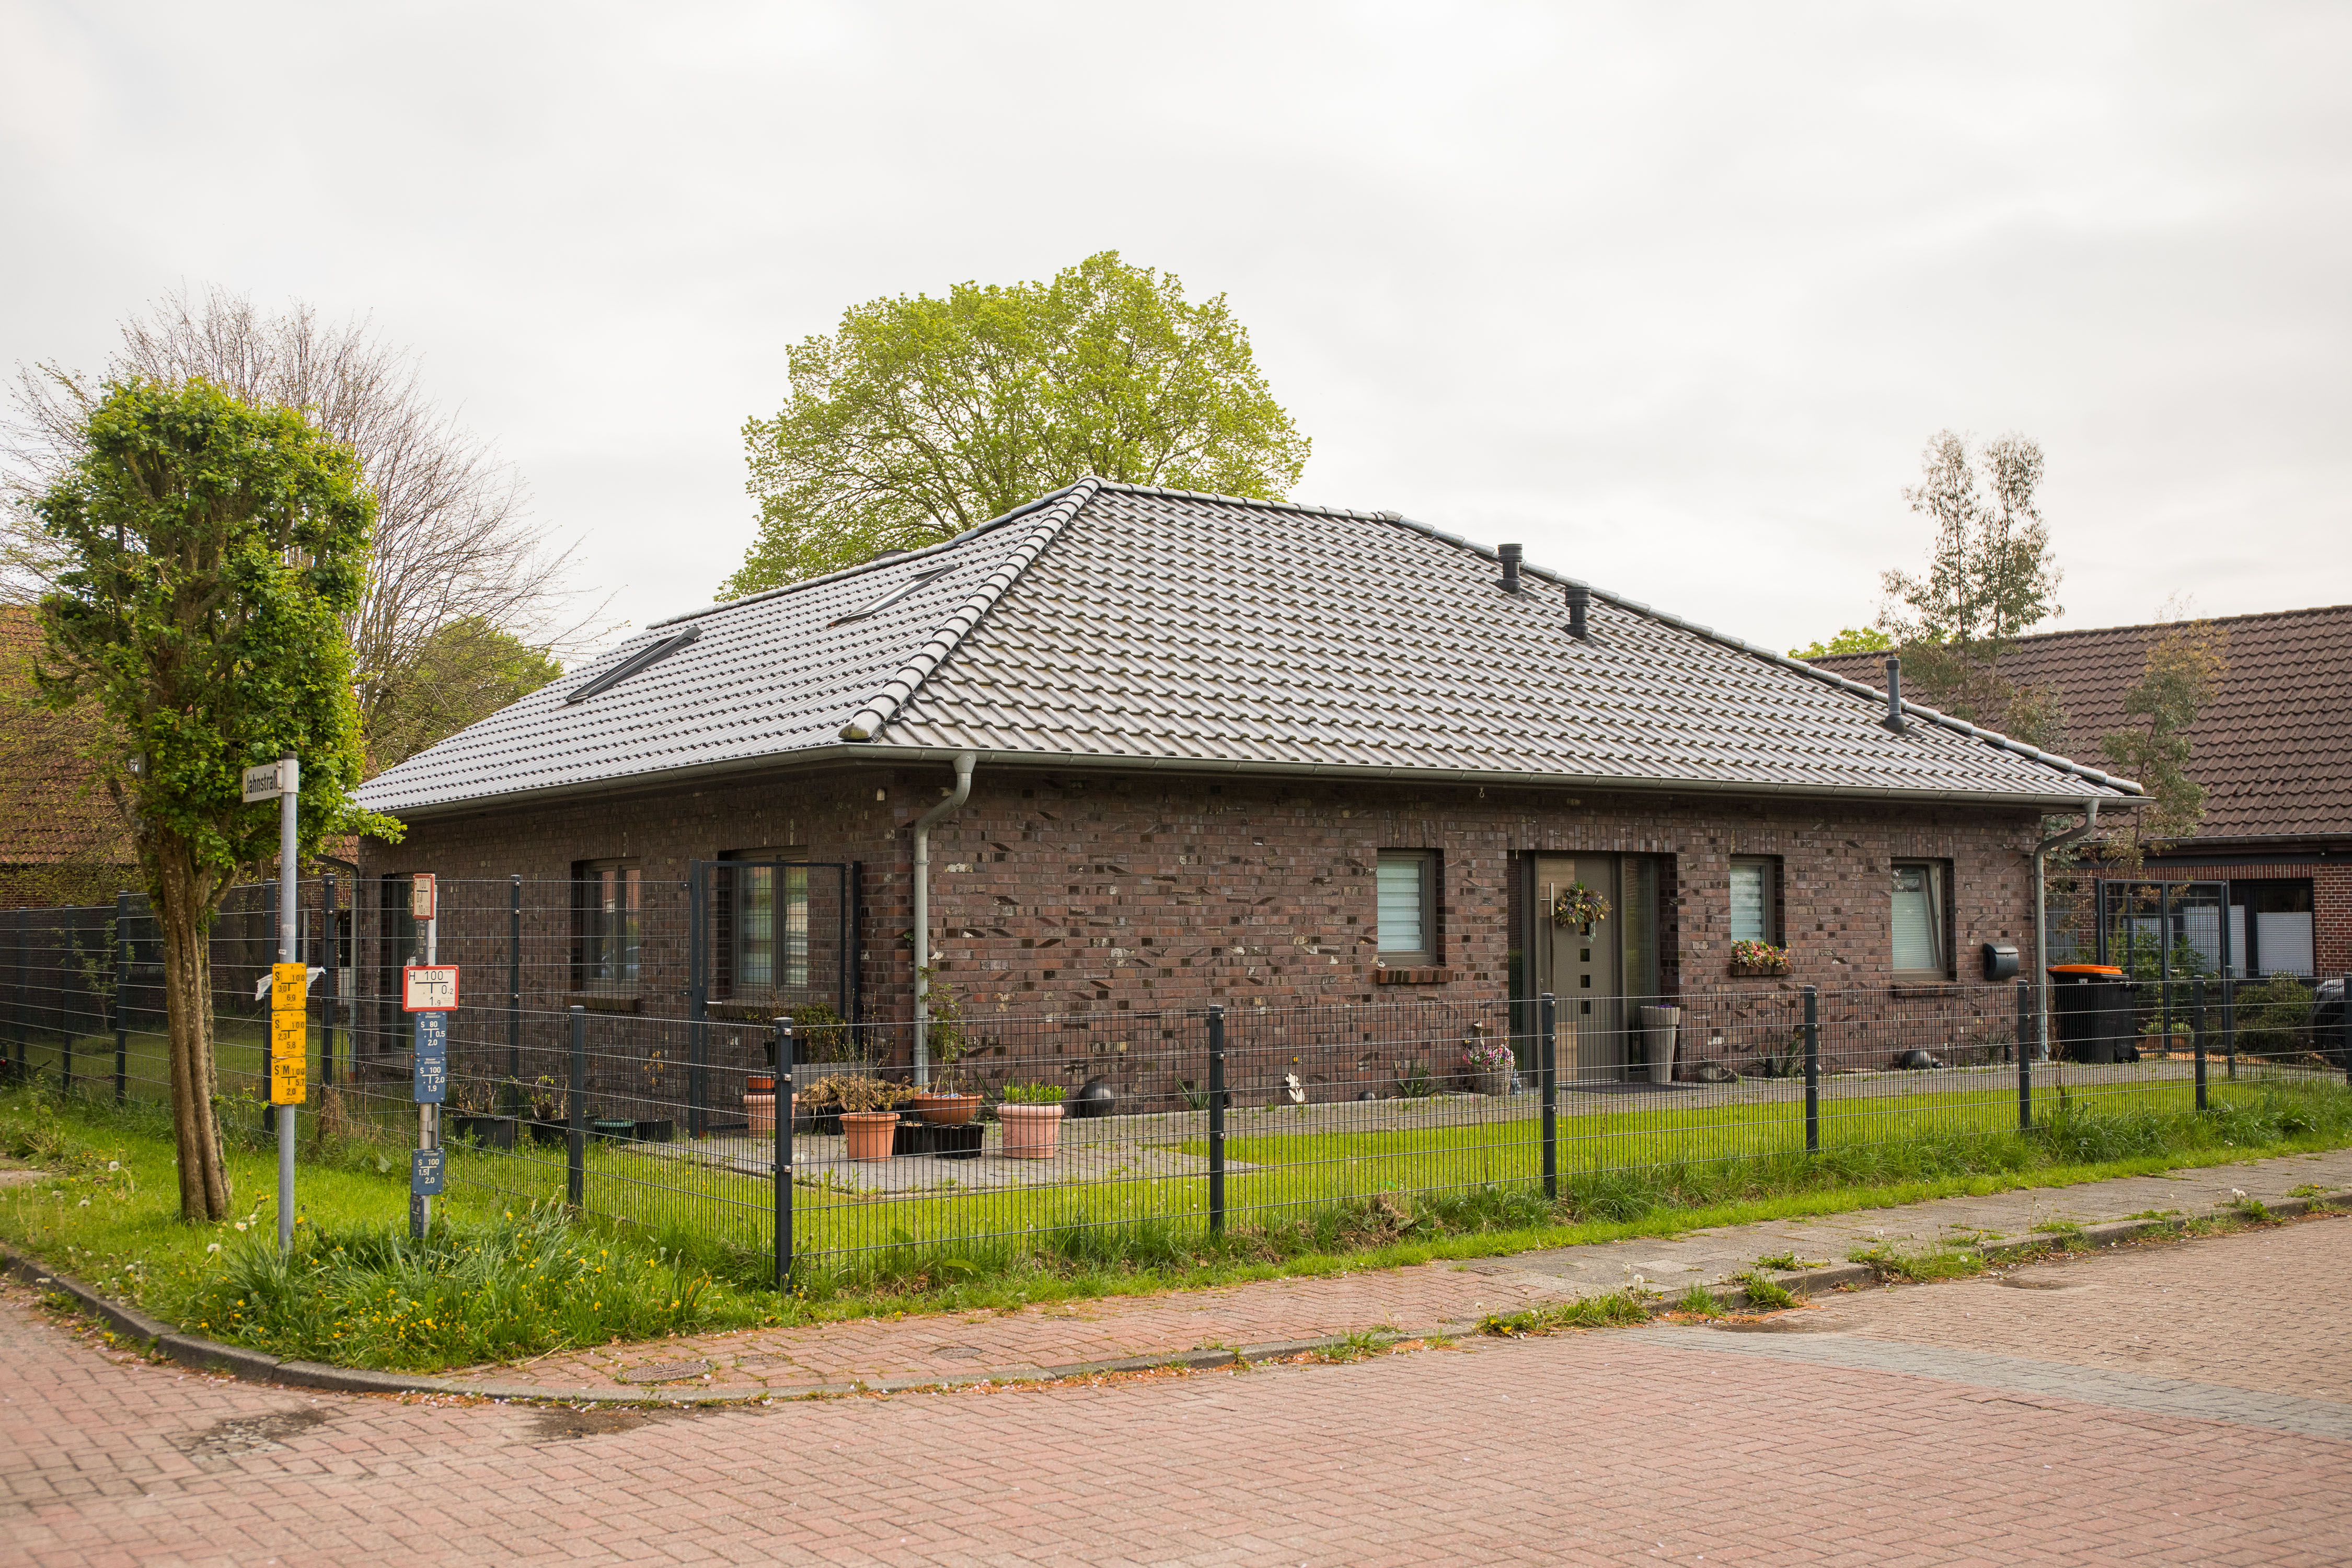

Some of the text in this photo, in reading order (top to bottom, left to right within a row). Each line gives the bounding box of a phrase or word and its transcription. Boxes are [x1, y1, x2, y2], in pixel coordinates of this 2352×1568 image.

[246, 769, 277, 794] Jahnstraß
[275, 972, 280, 981] S
[409, 971, 443, 981] H 100
[441, 985, 454, 995] 0.2
[429, 996, 441, 1006] 1.9
[275, 1020, 280, 1029] S
[274, 1065, 279, 1075] S
[283, 1065, 290, 1075] M
